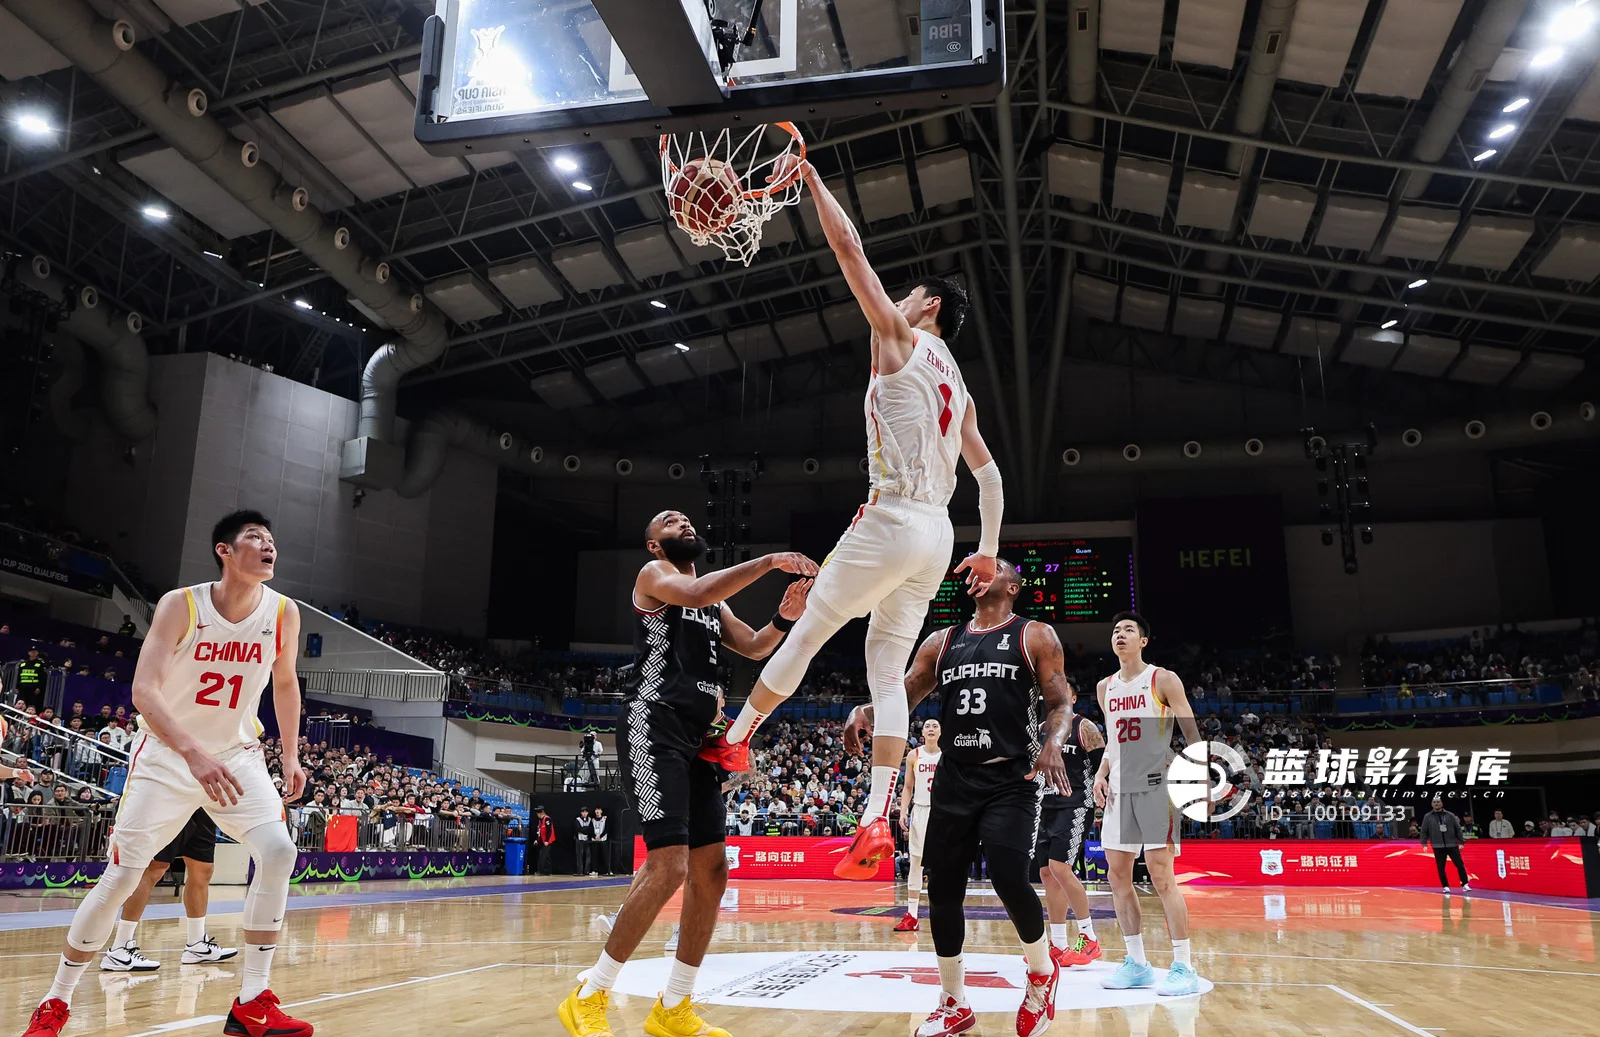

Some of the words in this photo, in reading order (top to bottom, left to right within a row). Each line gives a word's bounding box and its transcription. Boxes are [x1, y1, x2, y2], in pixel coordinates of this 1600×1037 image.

[926, 348, 944, 374] ZENG
[1045, 564, 1059, 572] 27
[1180, 548, 1251, 568] HEFEI
[2, 558, 16, 568] CUP
[17, 562, 33, 573] 2025
[34, 567, 68, 582] QUALIFIERS
[194, 641, 262, 664] CHINA
[942, 662, 1020, 685] GUAHAN
[195, 672, 243, 709] 21
[956, 688, 987, 715] 33
[1109, 694, 1146, 712] CHINA
[954, 736, 978, 747] Guam
[1116, 717, 1141, 743] 26
[743, 851, 804, 862] 一路向征程
[1286, 856, 1357, 867] 一路向征程
